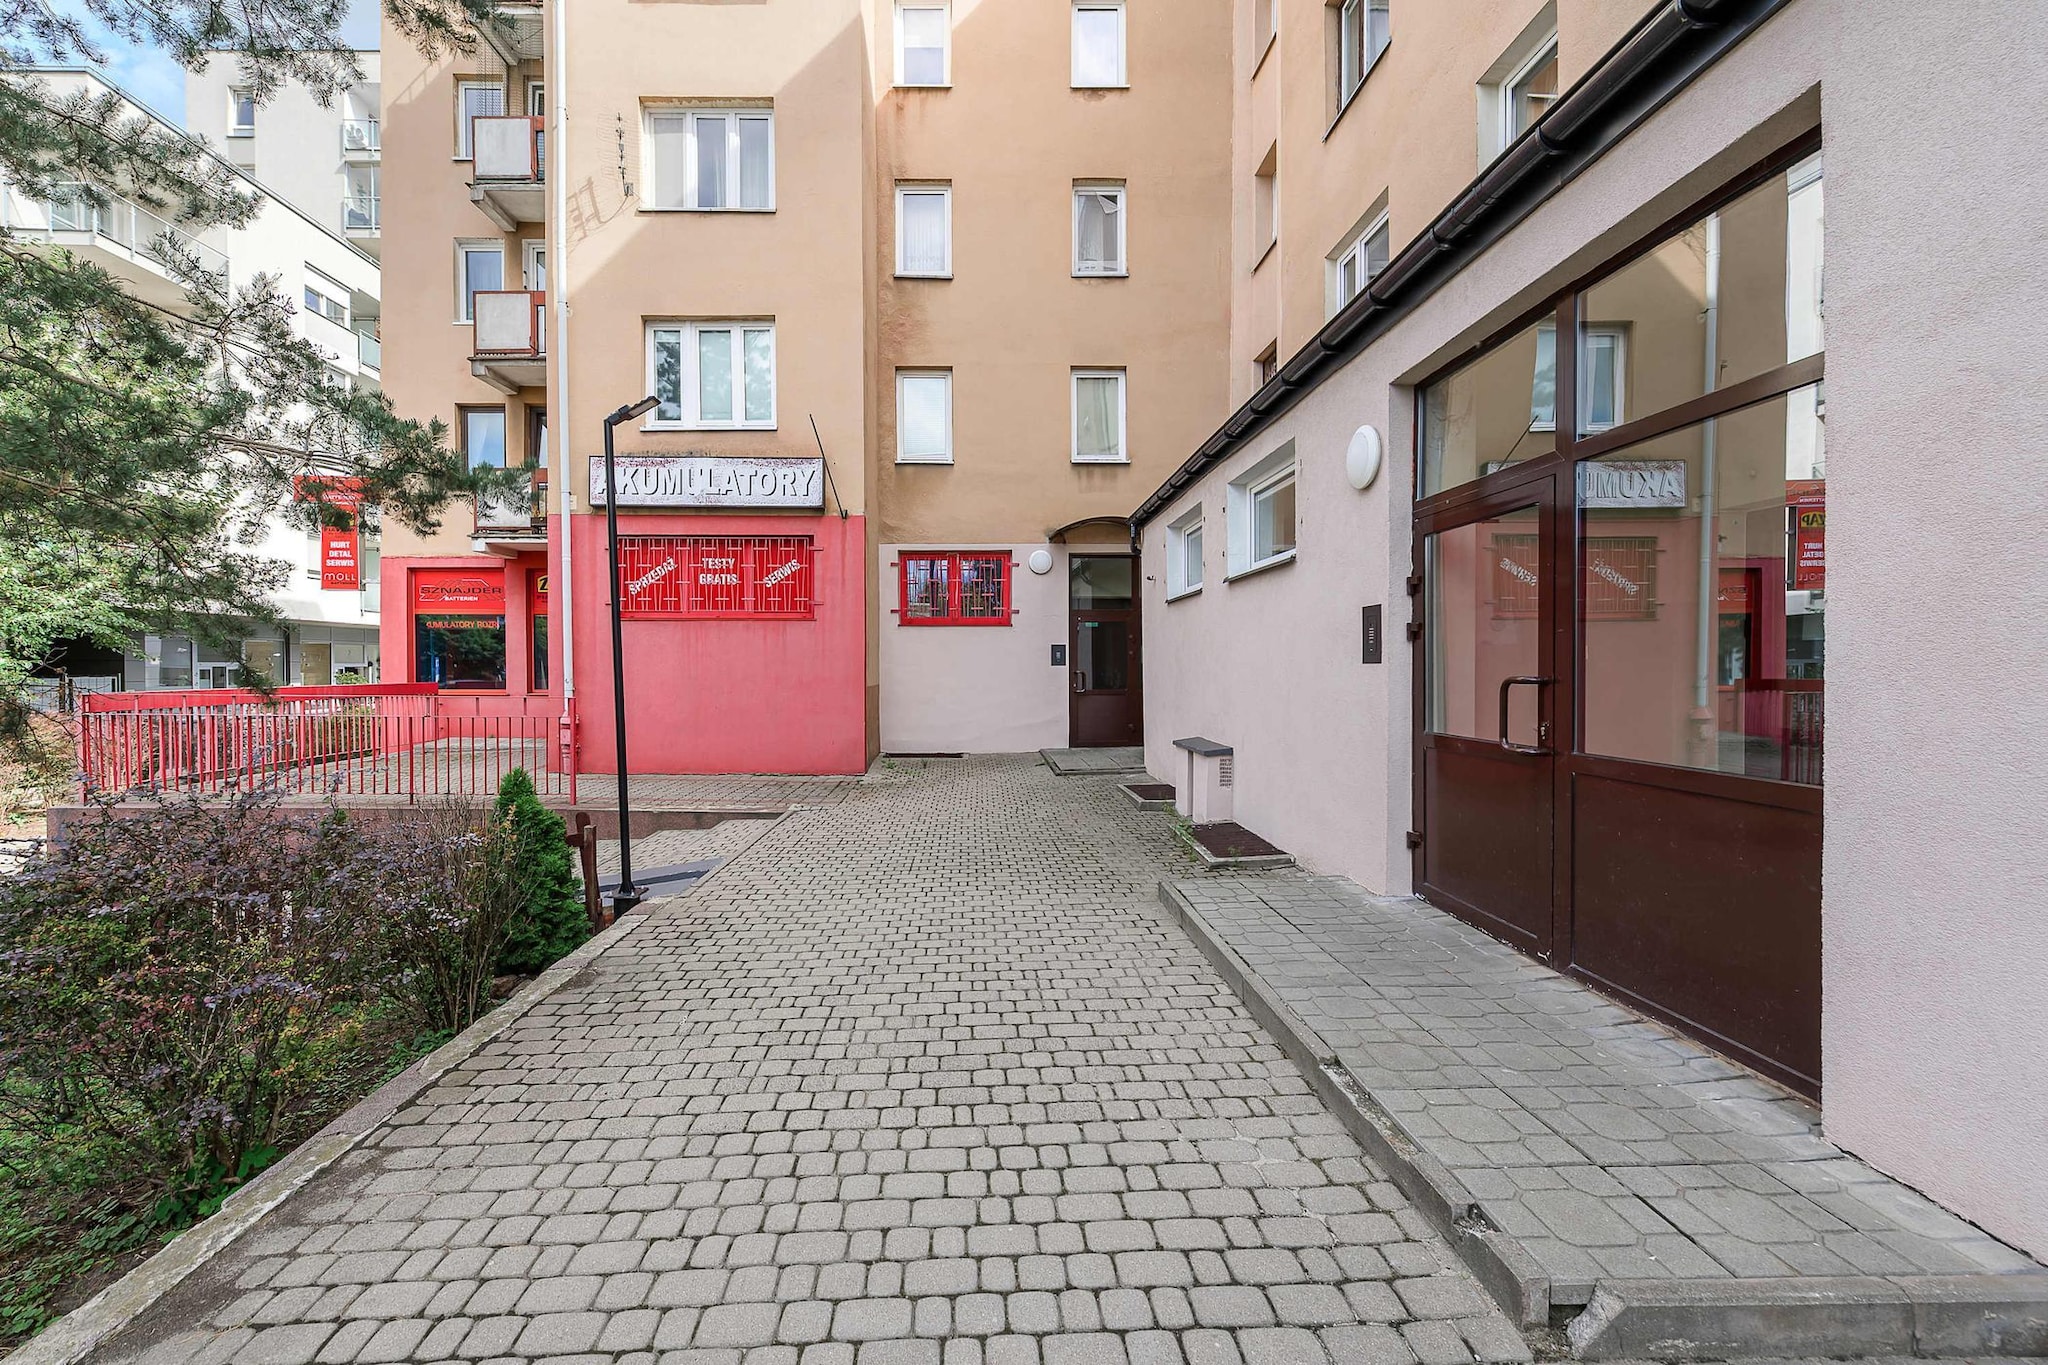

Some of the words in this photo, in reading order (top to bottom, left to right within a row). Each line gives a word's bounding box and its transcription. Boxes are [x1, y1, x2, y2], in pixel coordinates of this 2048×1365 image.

[330, 541, 351, 549] HURT
[328, 550, 353, 558] DETAL
[326, 559, 355, 567] SERWIS
[702, 557, 736, 569] TESTY
[763, 558, 802, 588] SERWIS
[699, 573, 739, 586] GRATIS
[420, 586, 503, 594] SZNAJDER
